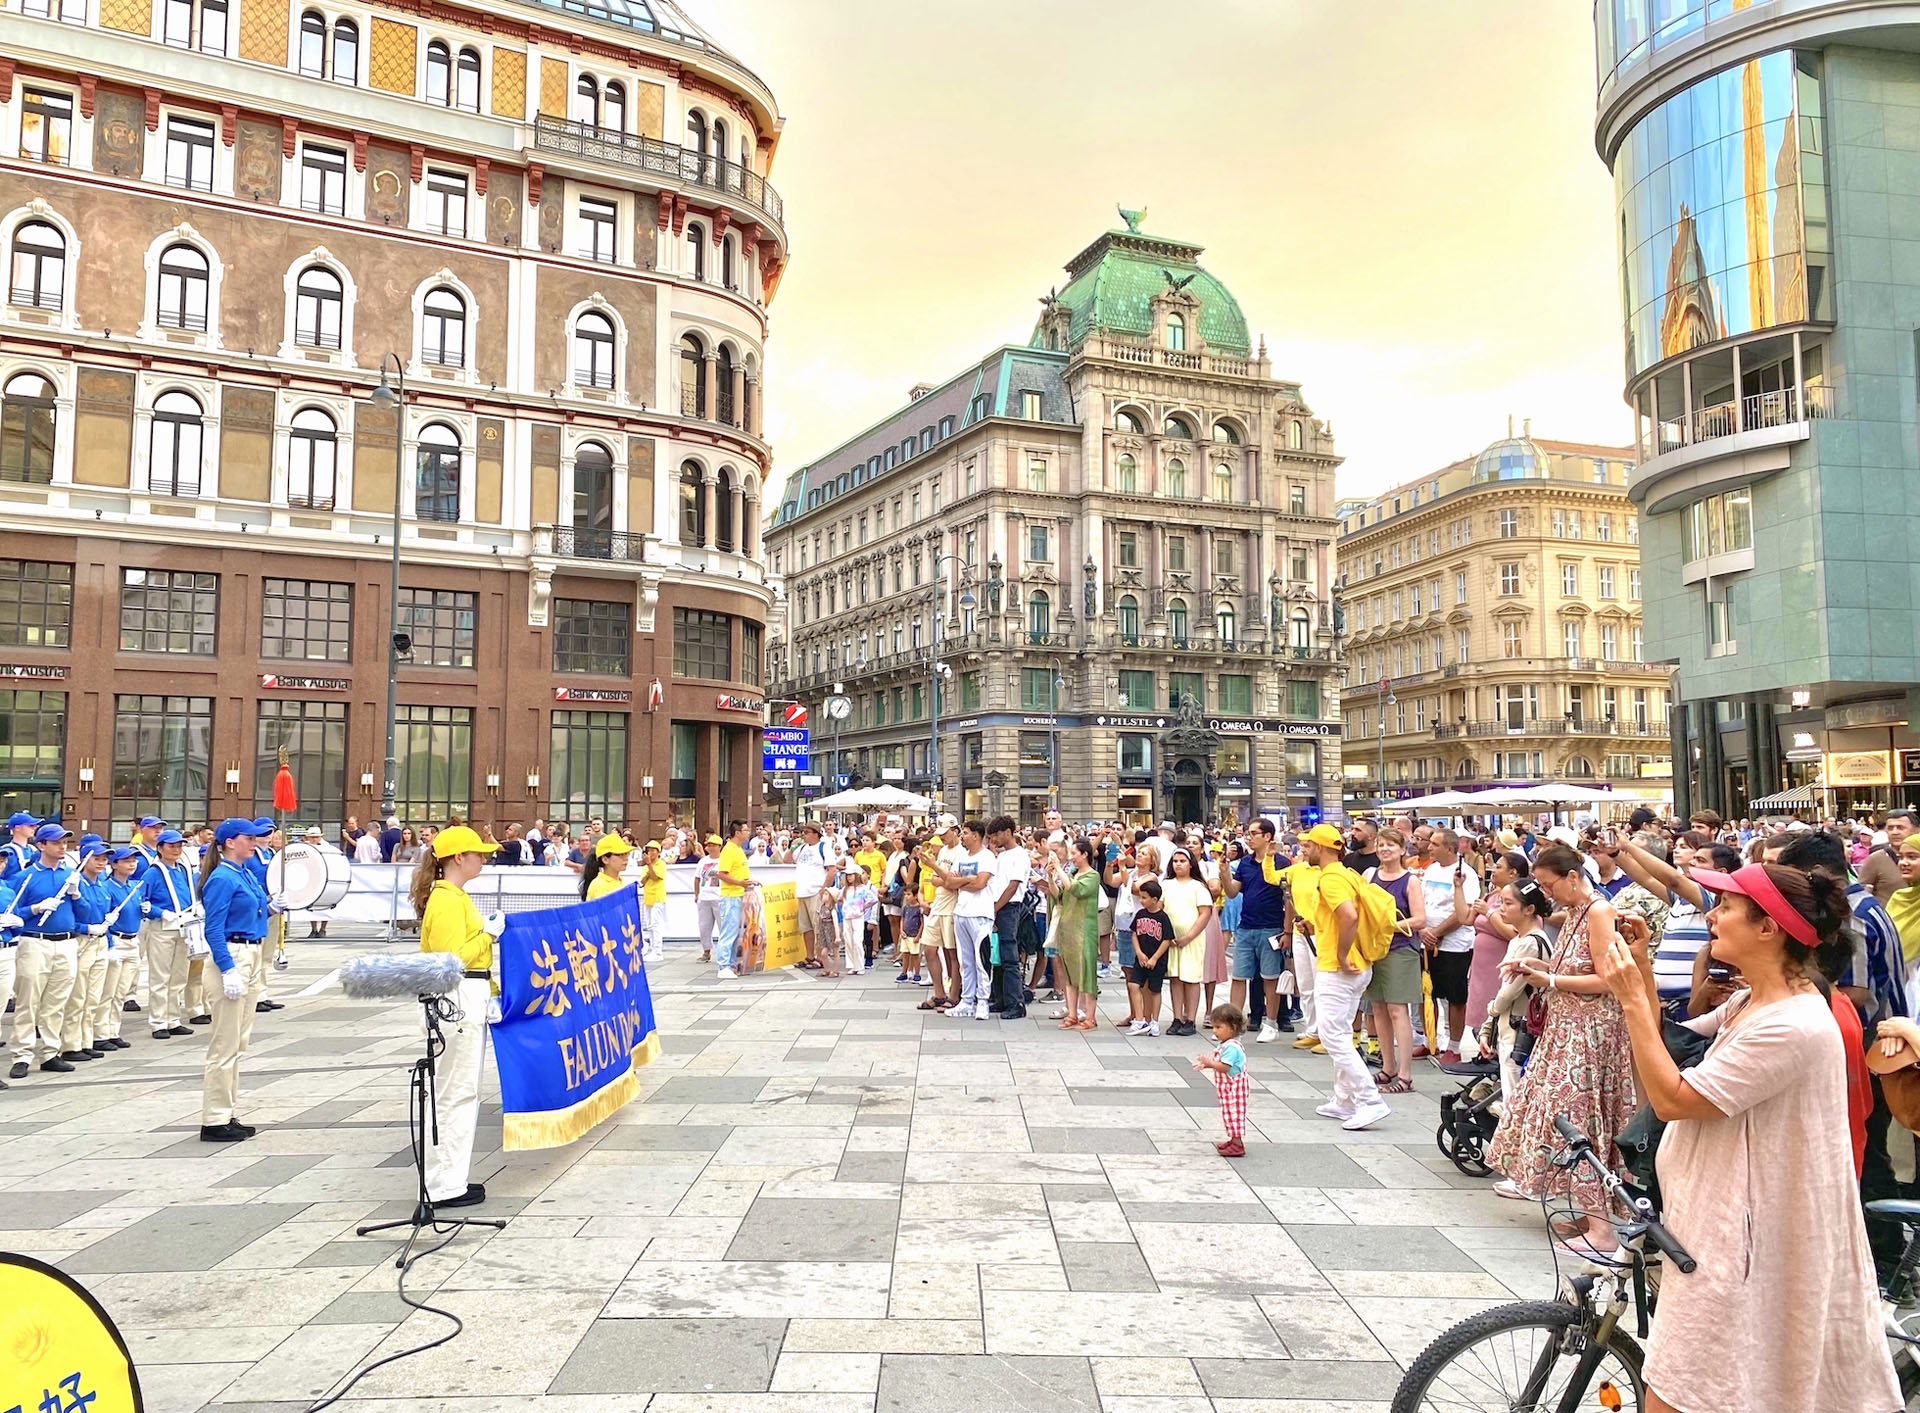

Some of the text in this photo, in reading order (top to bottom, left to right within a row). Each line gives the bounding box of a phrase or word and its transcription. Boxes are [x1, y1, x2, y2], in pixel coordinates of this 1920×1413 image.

[0, 664, 65, 677] nk Austria
[277, 675, 348, 689] Bank Austria
[569, 688, 630, 701] Bank Austria
[729, 695, 746, 709] Bank
[1110, 717, 1153, 726] PILSTL
[1221, 722, 1252, 731] OMEGA
[1289, 725, 1319, 734] OMEGA
[763, 744, 809, 755] CHANGE
[839, 776, 849, 787] U
[763, 891, 781, 904] Falun
[557, 1015, 622, 1092] FALUN
